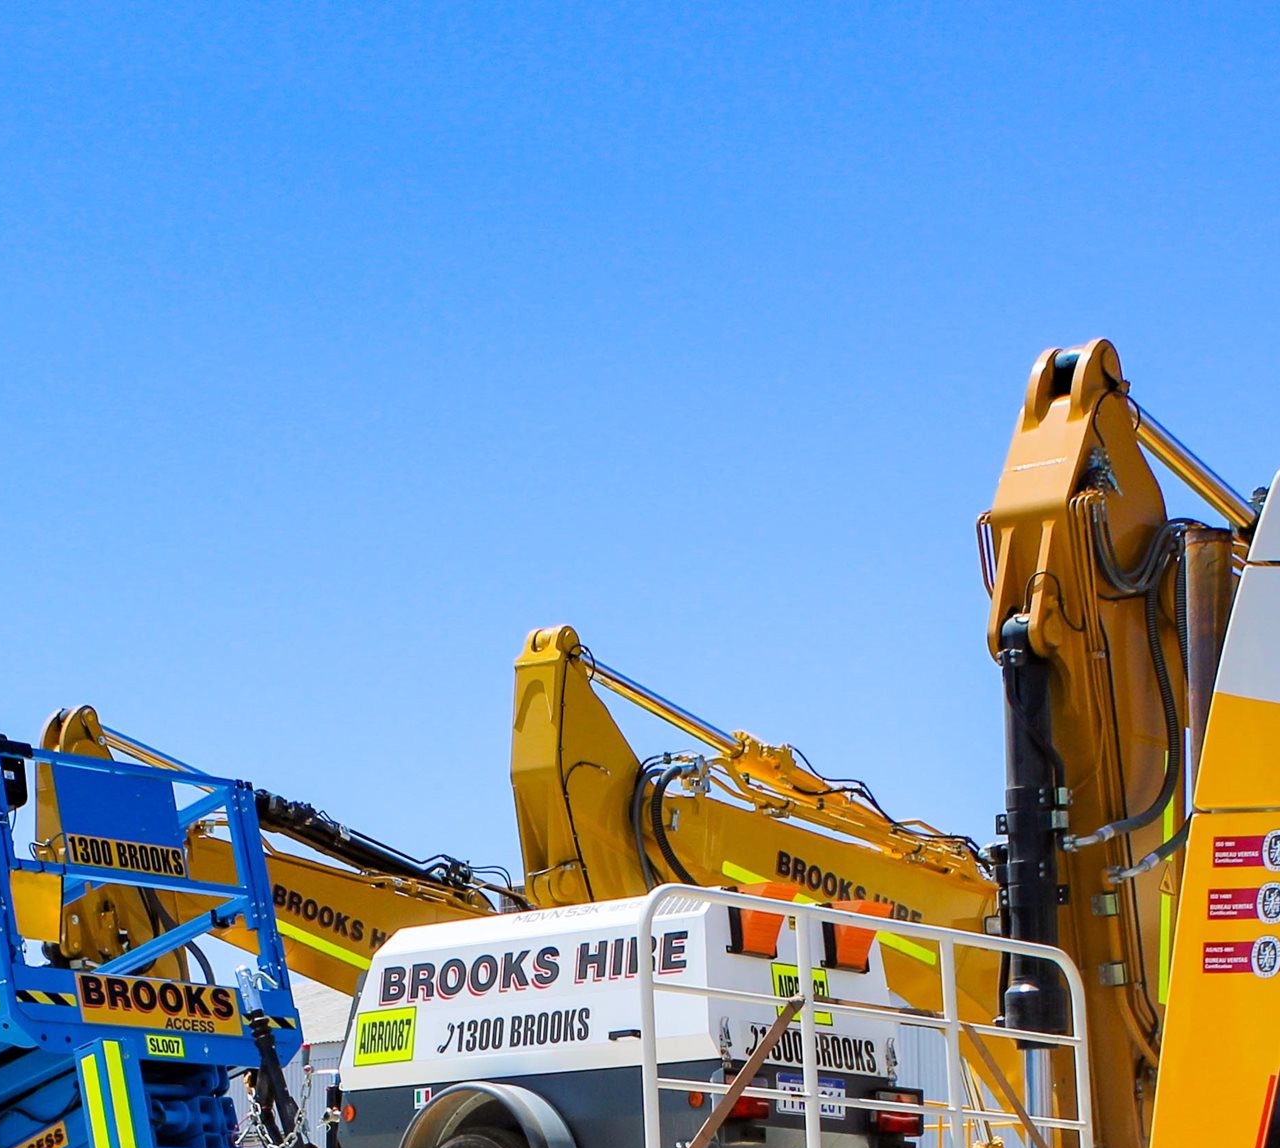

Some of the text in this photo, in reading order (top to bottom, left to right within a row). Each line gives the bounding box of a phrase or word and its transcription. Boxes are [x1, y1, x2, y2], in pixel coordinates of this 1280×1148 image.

[69, 837, 185, 876] 1300 BROOKS
[775, 850, 867, 901] BROOKS
[272, 883, 365, 942] BROOKS
[78, 974, 236, 1020] BROOKS
[378, 946, 561, 1006] BROOKS
[149, 1037, 181, 1055] SL007
[165, 1016, 215, 1033] ACCESS
[358, 1018, 413, 1056] AIRR0087
[456, 1007, 591, 1053] 1300 BROOKS
[814, 1034, 877, 1074] BROOKS
